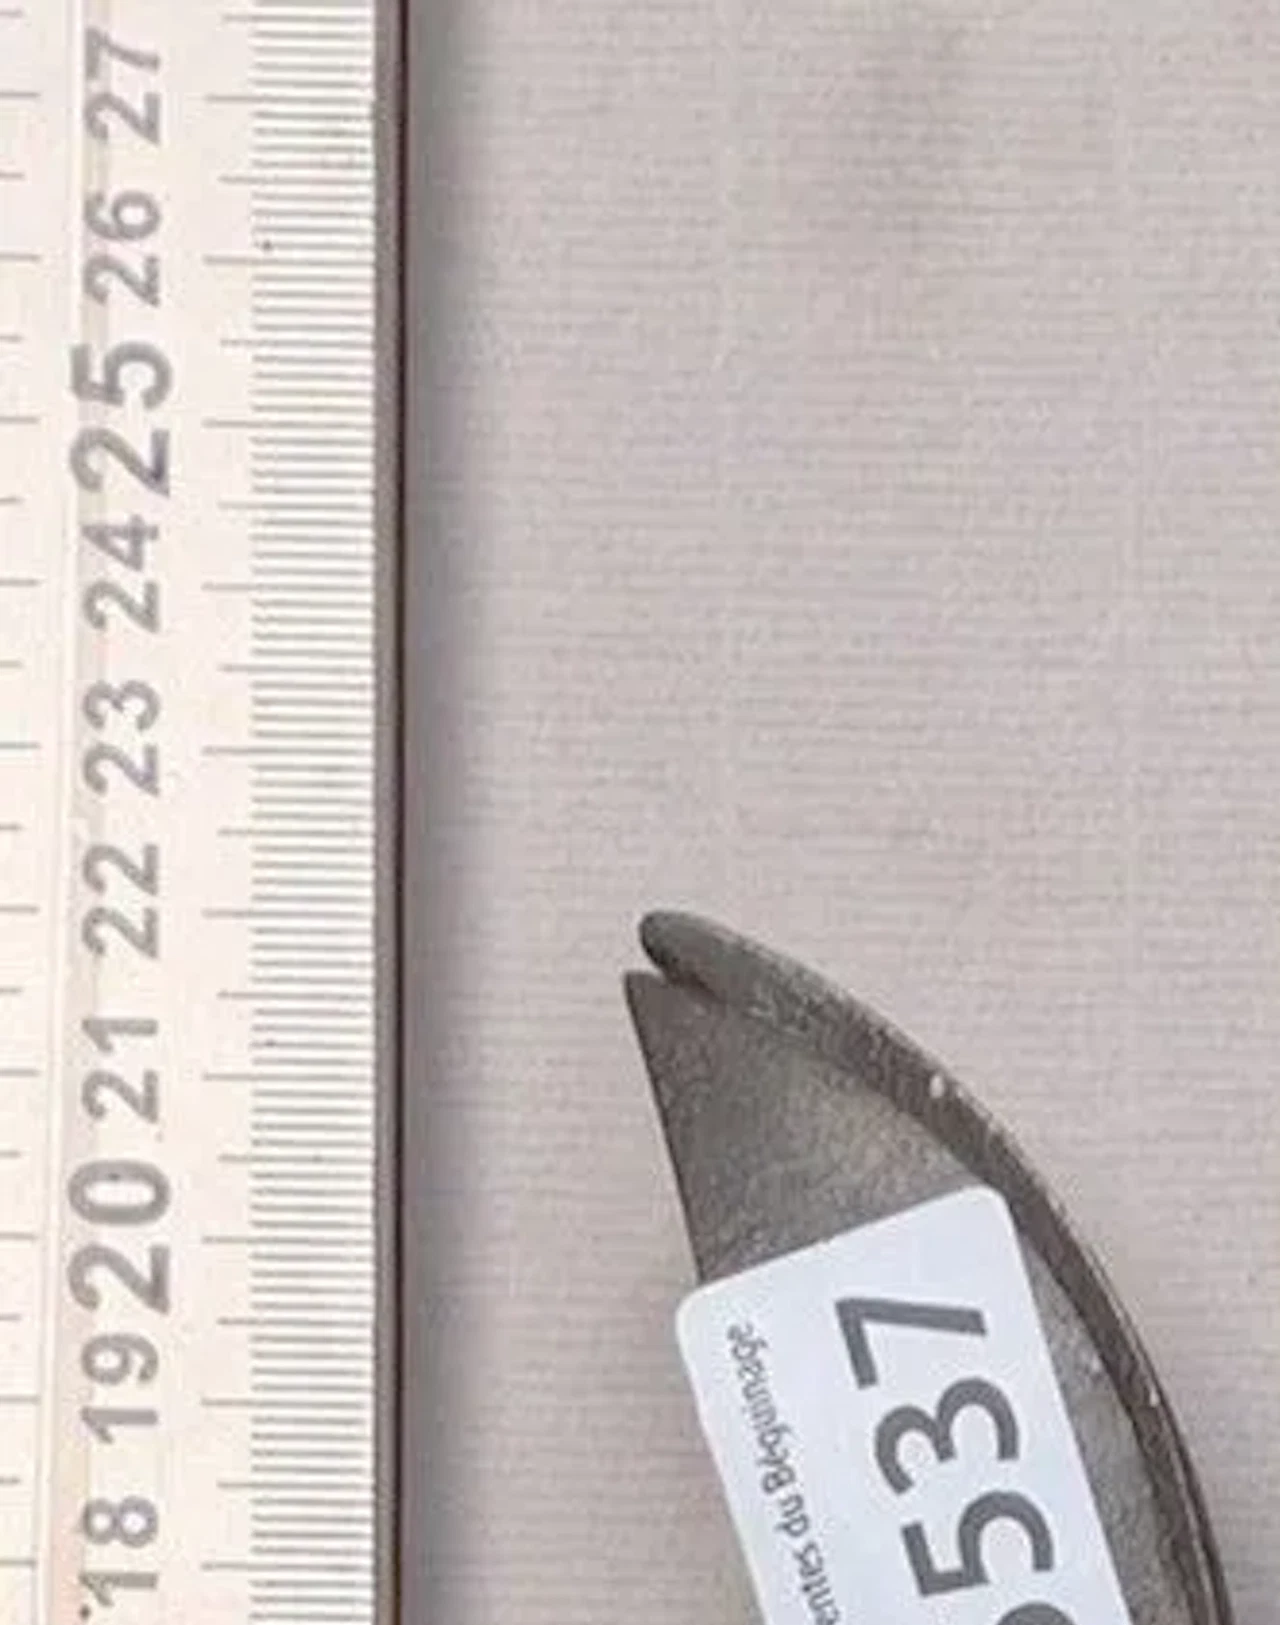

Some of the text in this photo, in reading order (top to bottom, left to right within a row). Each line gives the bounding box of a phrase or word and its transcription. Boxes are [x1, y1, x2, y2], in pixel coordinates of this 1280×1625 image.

[83, 27, 160, 145] 27
[83, 191, 161, 307] 26
[70, 344, 170, 496] 25
[81, 515, 159, 632] 24
[81, 681, 159, 796] 23
[81, 844, 158, 958] 22
[81, 1017, 158, 1123] 21
[67, 1162, 169, 1314] 20
[80, 1334, 158, 1444] 19
[727, 1322, 798, 1494] Béguinage
[80, 1497, 158, 1607] 18
[774, 1494, 810, 1538] du
